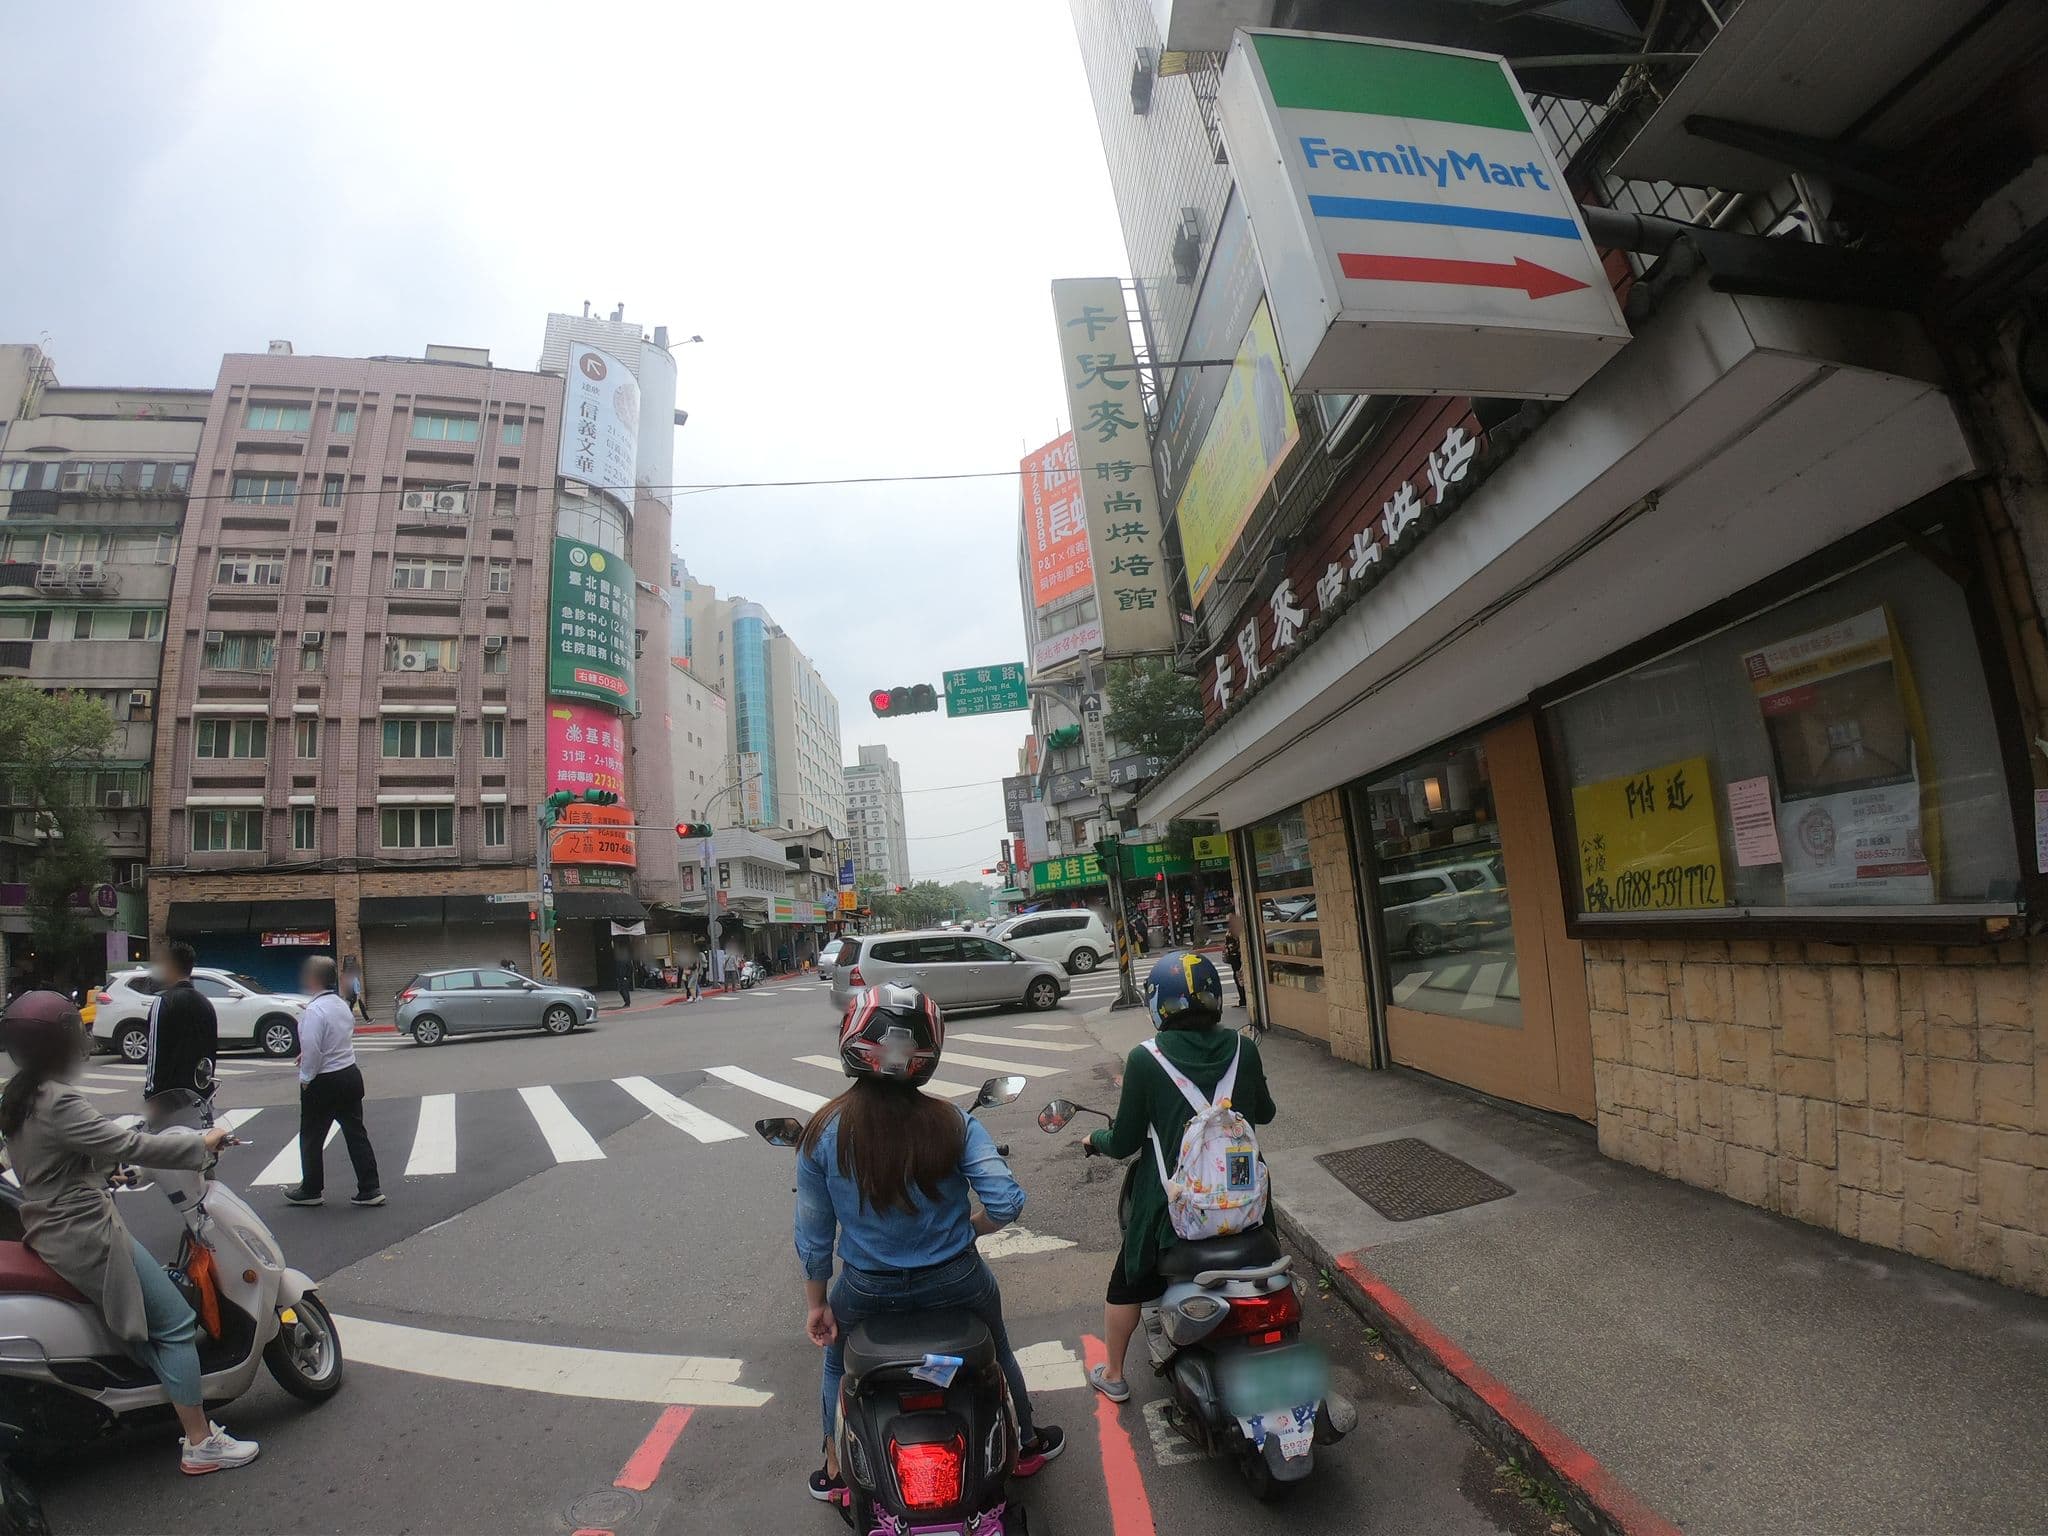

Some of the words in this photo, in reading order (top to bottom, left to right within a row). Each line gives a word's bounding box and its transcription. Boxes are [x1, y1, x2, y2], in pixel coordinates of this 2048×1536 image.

[1300, 137, 1550, 191] FamilyMart
[576, 401, 600, 473] 信義文華
[561, 606, 608, 627] 急診中心
[561, 622, 608, 643] 門診中心
[561, 640, 608, 661] 住院服務
